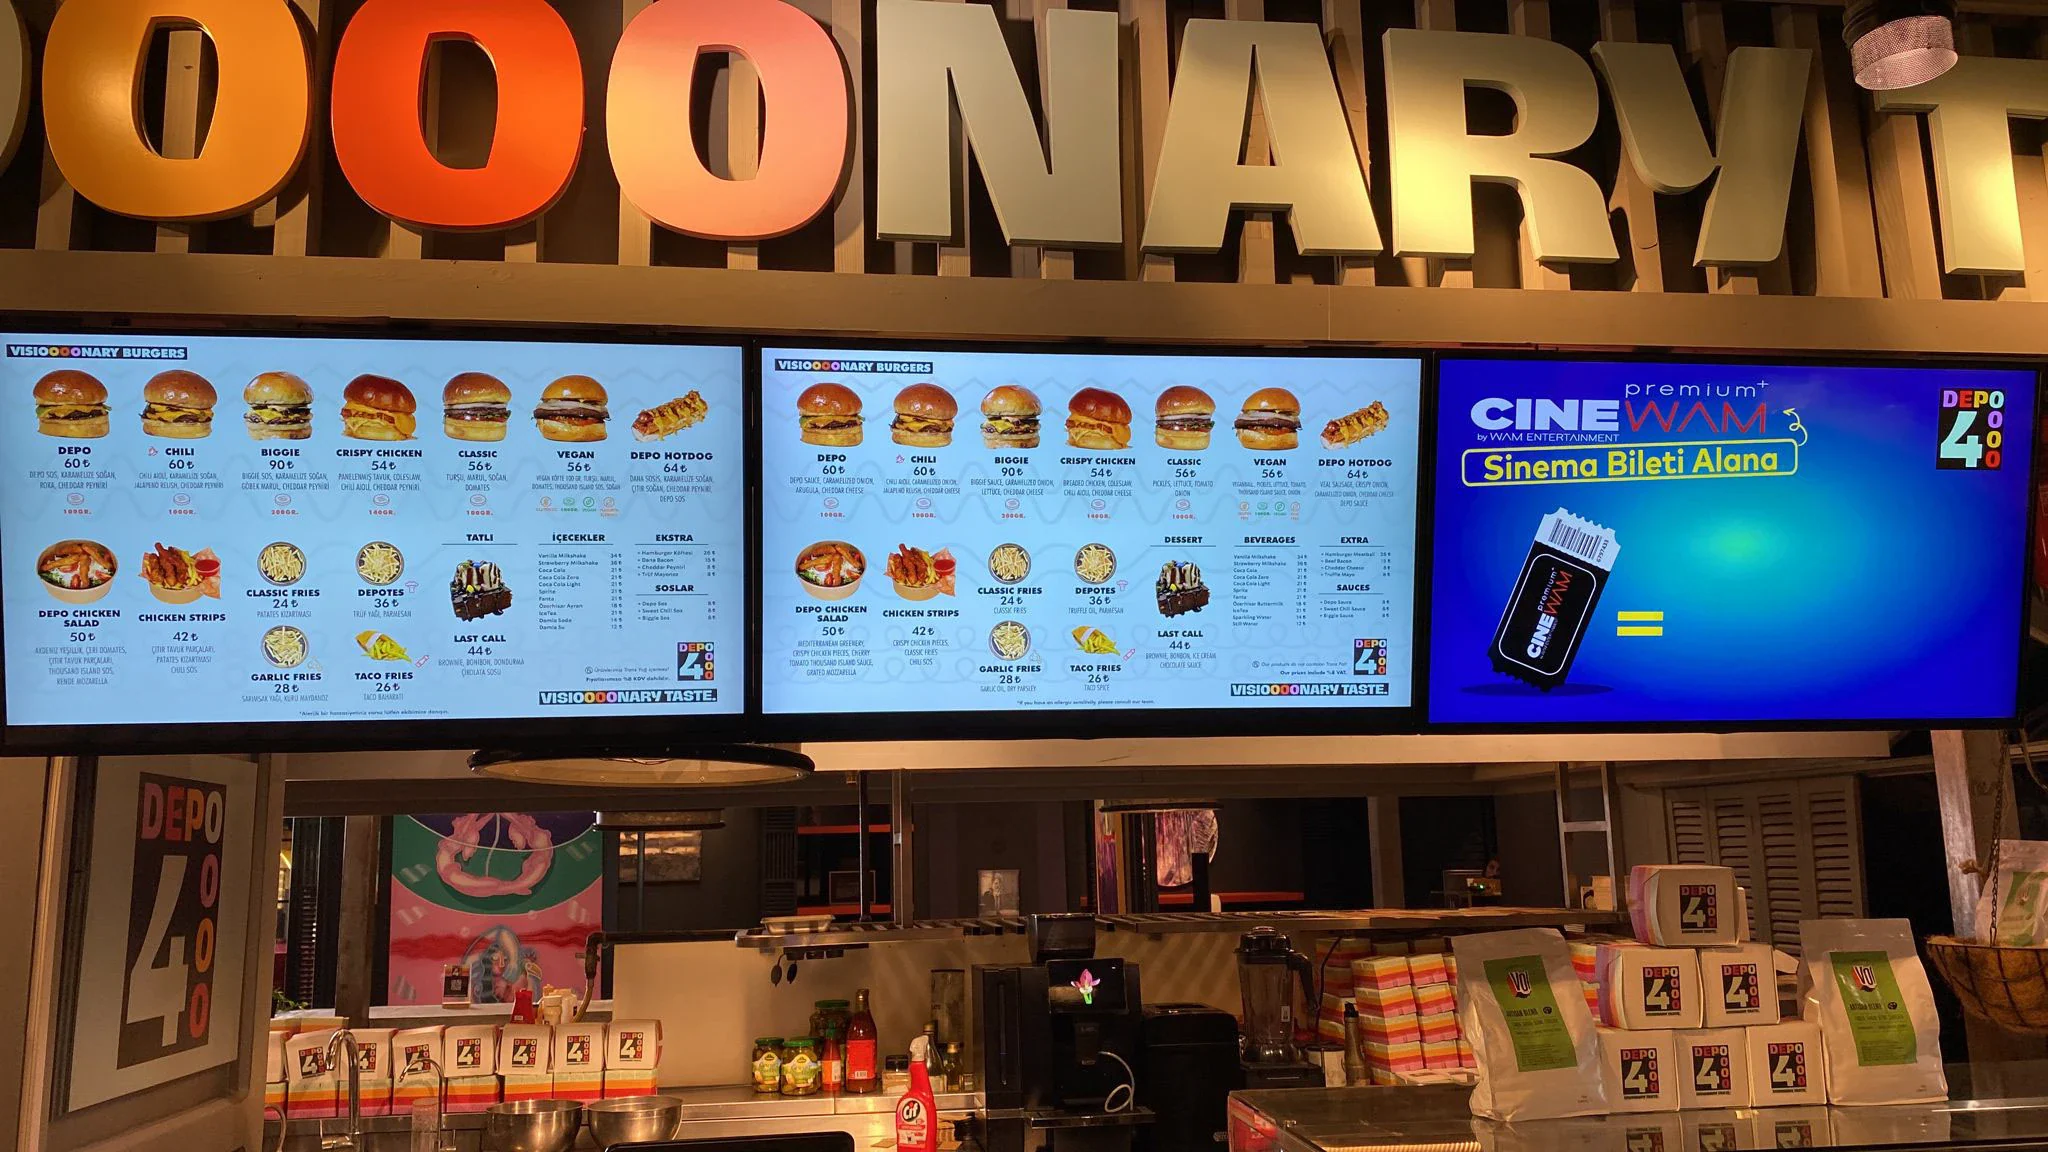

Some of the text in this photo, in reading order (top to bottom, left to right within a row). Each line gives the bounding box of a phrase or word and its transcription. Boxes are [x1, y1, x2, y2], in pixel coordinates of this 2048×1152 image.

[0, 0, 1812, 270] OOONARY
[122, 348, 185, 359] BURGERS
[877, 362, 931, 372] BURGERS
[1942, 390, 2005, 409] DEPO
[1470, 397, 1766, 434] CINE WAM
[1476, 432, 1619, 442] by WAM ENTERTAINMENT
[1940, 410, 1982, 468] 4
[58, 446, 91, 455] DEPO
[165, 448, 195, 456] CHILI
[261, 449, 300, 457] BIGGIE
[336, 449, 423, 457] CRISPY CHICKEN
[458, 450, 497, 458] CLASSIC
[557, 451, 595, 459] VEGAN
[630, 451, 713, 461] DEPO HOTDOG
[817, 454, 846, 462] DEPO
[994, 457, 1029, 465] BIGGIE
[1060, 457, 1136, 465] CRISPY CHICKEN
[1167, 458, 1201, 466] CLASSIC
[1318, 459, 1392, 467] DEPO HOTDOG
[1483, 448, 1778, 481] Sinema Bileti Alana
[552, 532, 605, 543] İÇECEKLER
[655, 534, 693, 542] EKSTRA
[1244, 536, 1295, 544] BEVERAGES
[1340, 536, 1368, 544] EXTRA
[655, 584, 694, 592] SOSLAR
[246, 589, 320, 597] CLASSIC FRIES
[358, 589, 405, 597] DEPOTES
[38, 610, 69, 618] DEPO
[139, 614, 186, 622] CHICKEN
[63, 619, 100, 627] SALAD
[454, 635, 479, 643] LAST
[979, 665, 1014, 673] GARLIC
[251, 672, 322, 681] GARLIC FRIES
[355, 672, 413, 680] TACO FRIES
[1341, 684, 1388, 694] TASTE.
[664, 690, 717, 702] TASTE.
[141, 782, 223, 844] DEPO
[126, 855, 187, 1047] 4
[903, 1101, 918, 1120] Cif
